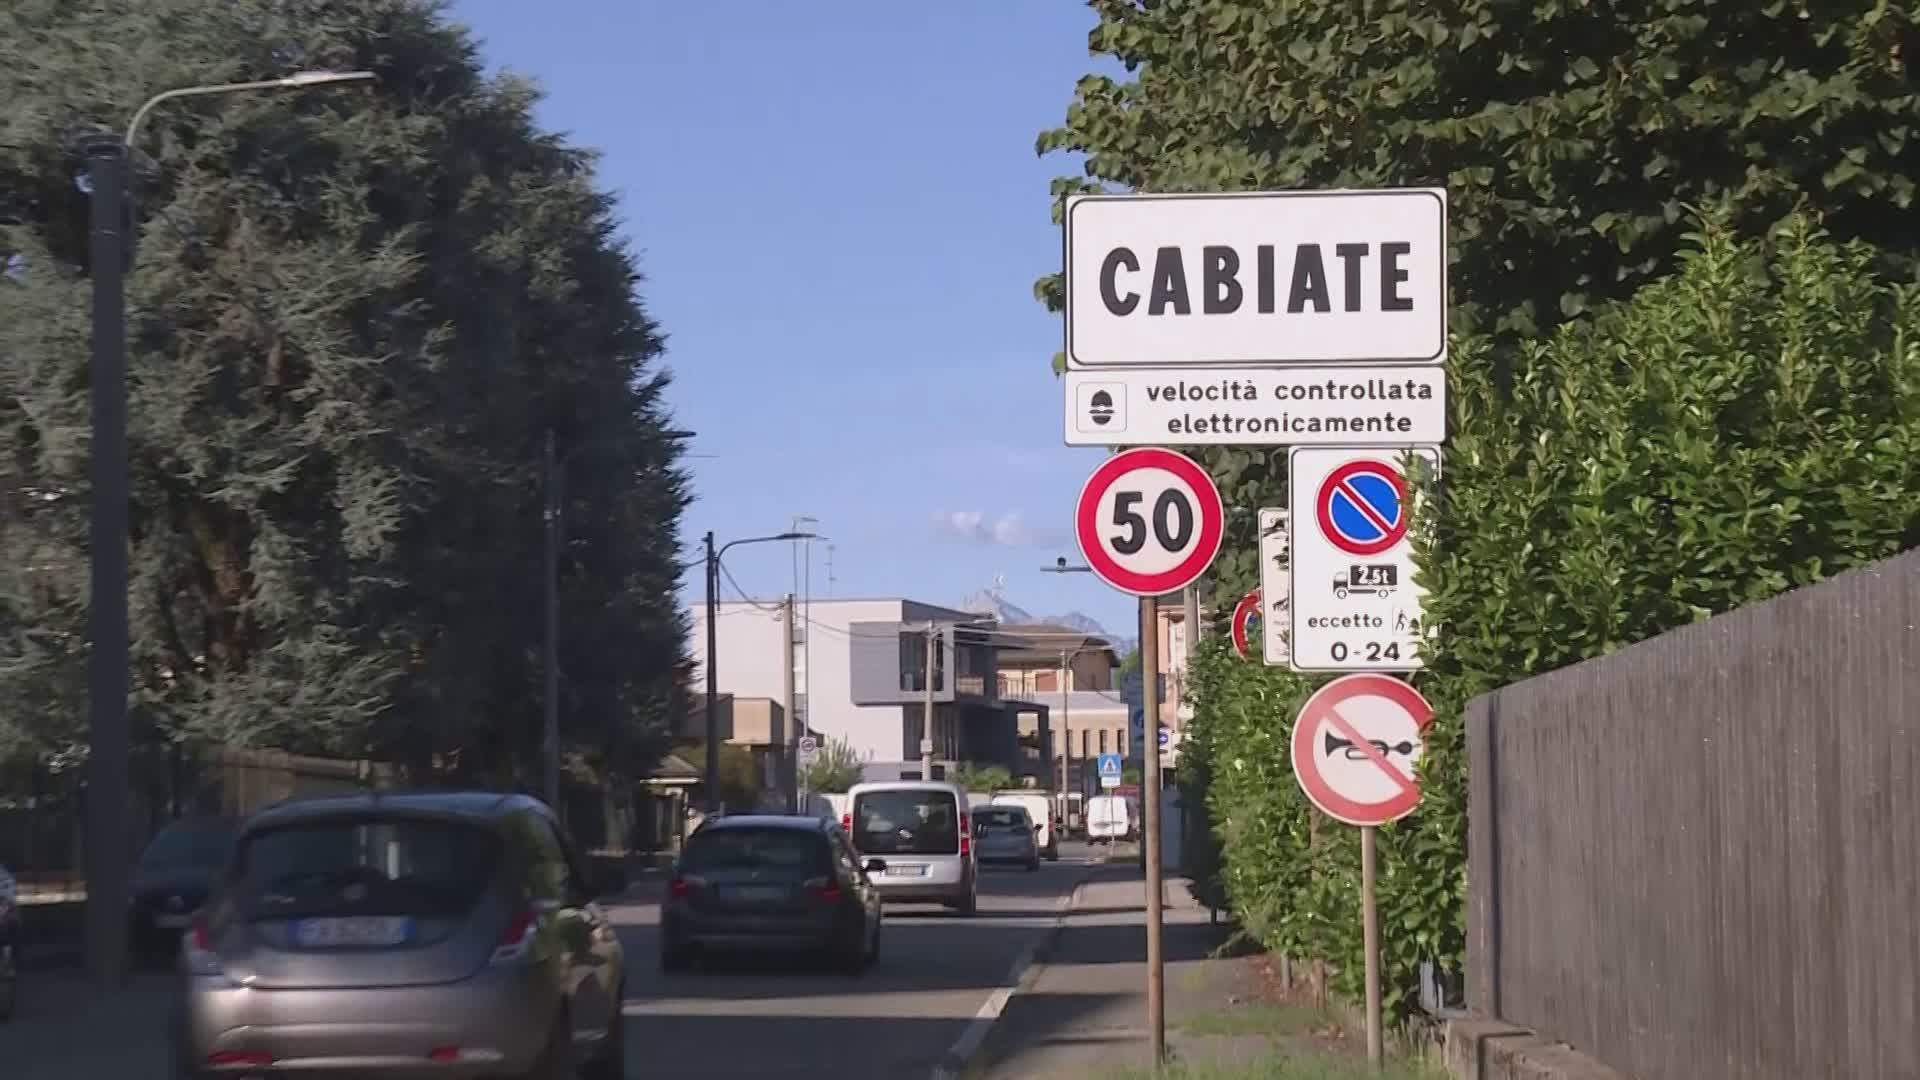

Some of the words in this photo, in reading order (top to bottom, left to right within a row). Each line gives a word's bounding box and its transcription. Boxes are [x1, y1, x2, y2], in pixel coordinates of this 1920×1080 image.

[1099, 241, 1414, 317] CABIATE
[1146, 379, 1258, 402] velocità
[1274, 379, 1433, 401] controllata
[1167, 412, 1412, 434] elettronicamente
[1110, 487, 1194, 556] 50
[1307, 613, 1384, 629] eccetto
